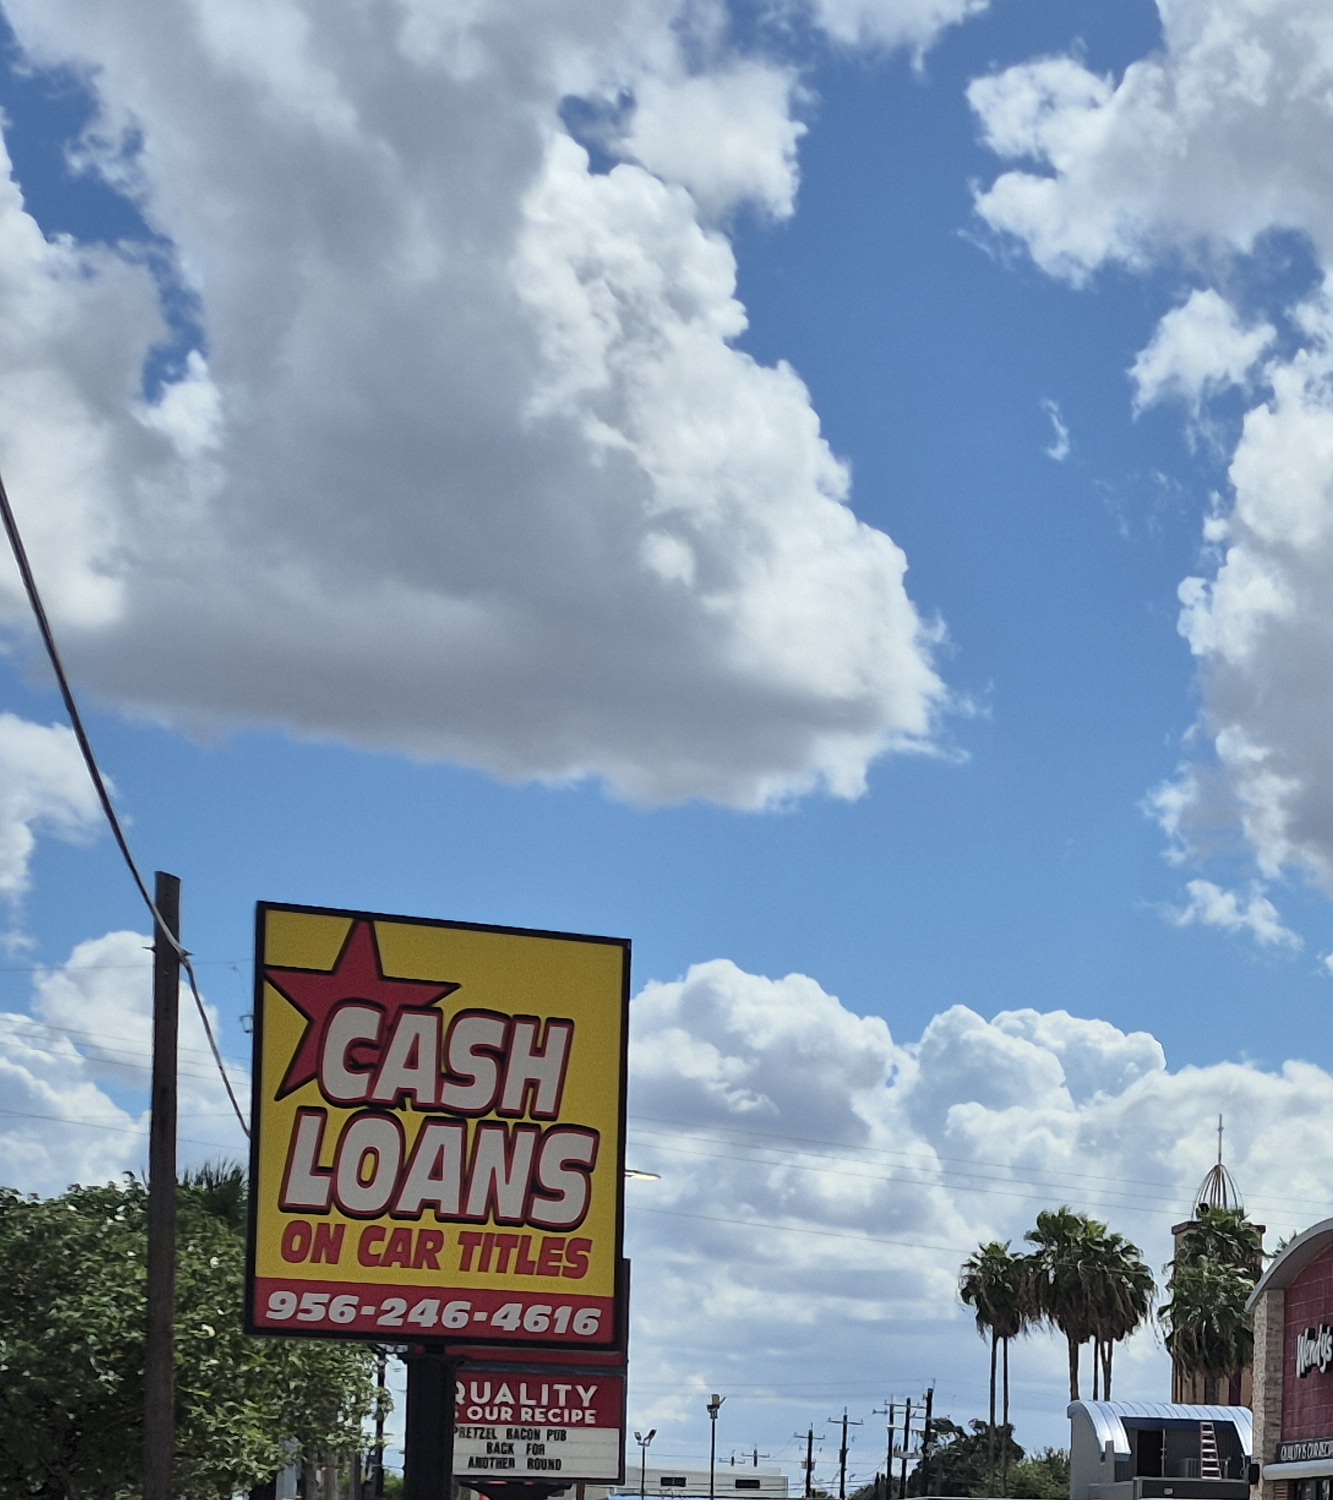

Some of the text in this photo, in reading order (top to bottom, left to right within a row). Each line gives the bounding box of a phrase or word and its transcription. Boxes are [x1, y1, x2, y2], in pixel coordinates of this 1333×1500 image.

[318, 998, 574, 1119] CASH
[280, 1106, 600, 1231] LOANS
[281, 1219, 593, 1279] ON CAR TITLES
[266, 1291, 602, 1336] 956-246-4616
[466, 1405, 513, 1422] OUR
[520, 1408, 597, 1424] RECIPE
[486, 1442, 546, 1456] BACK FOR
[506, 1428, 541, 1441] BACON
[546, 1429, 567, 1441] PUB
[468, 1456, 562, 1471] ANOTHER ROUND
